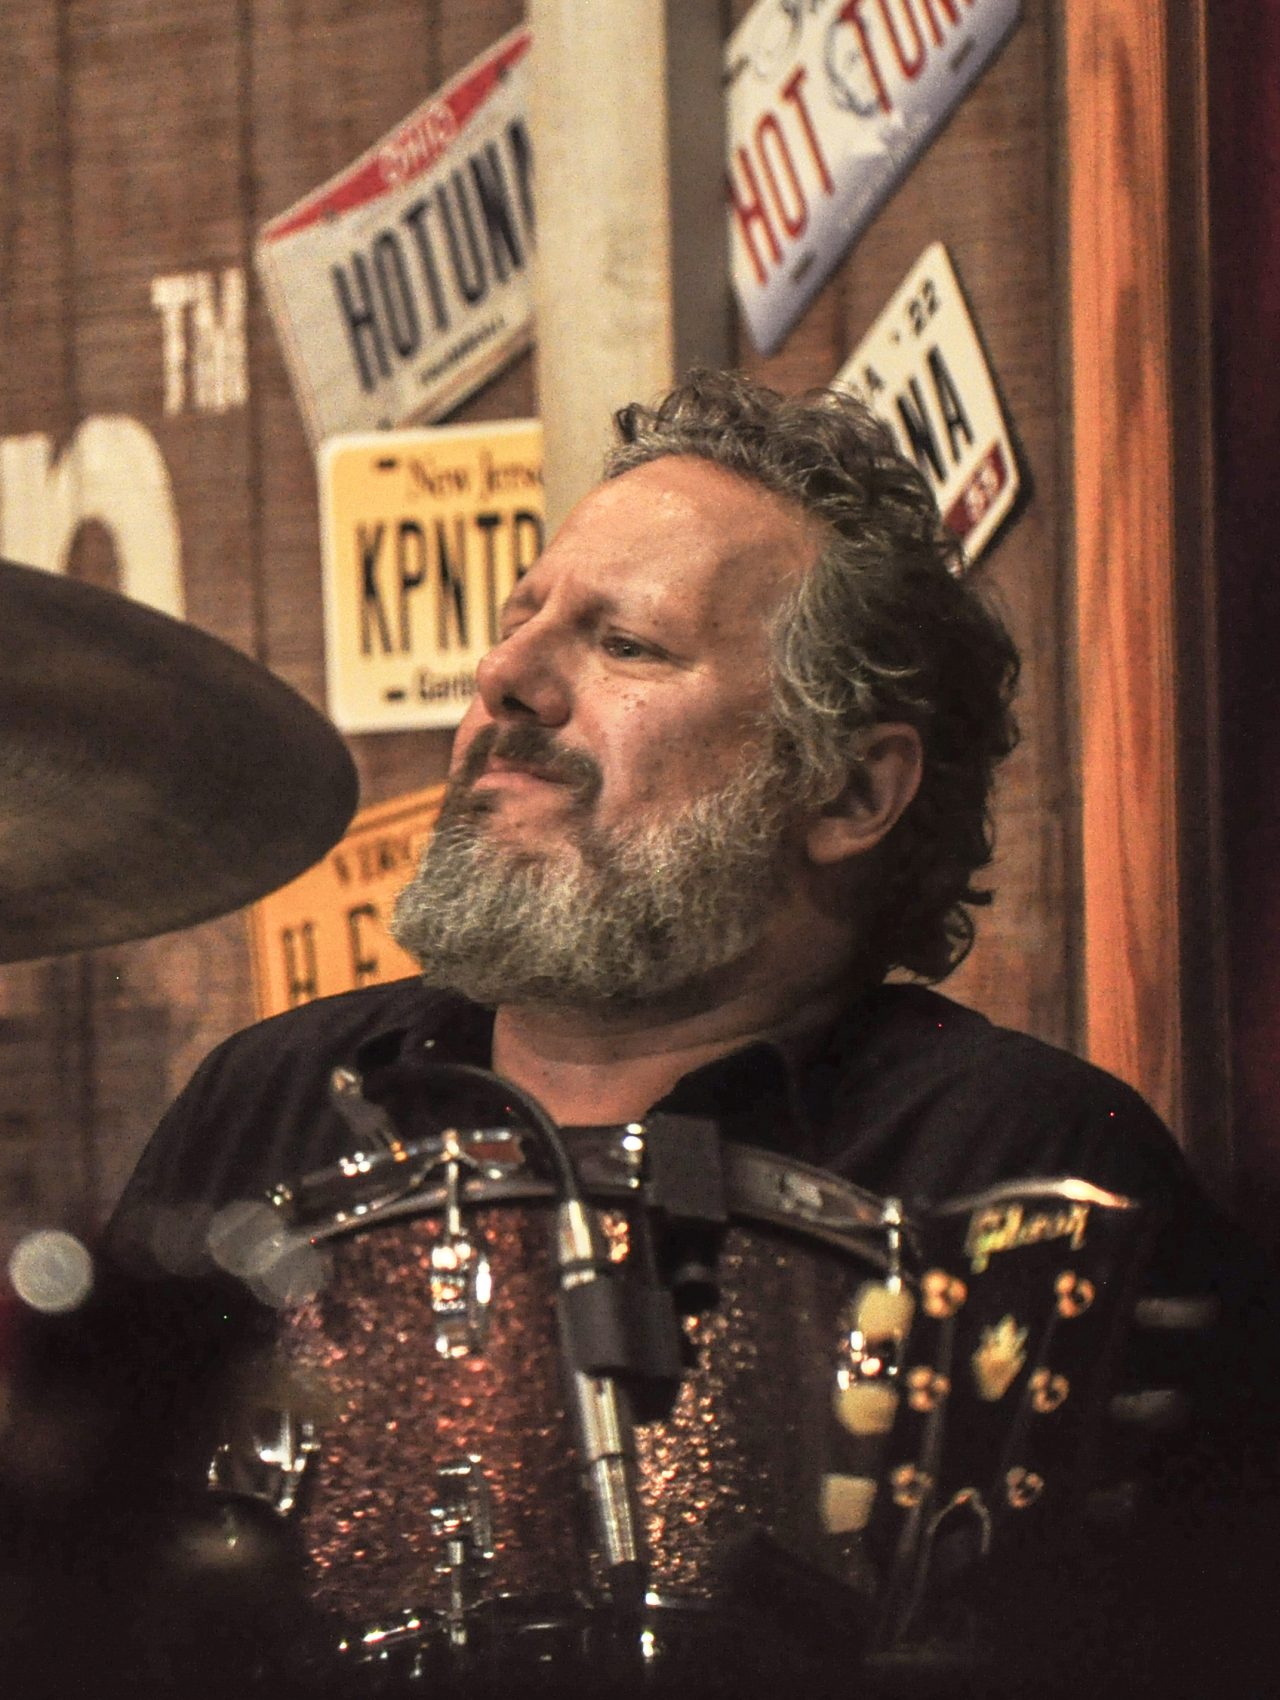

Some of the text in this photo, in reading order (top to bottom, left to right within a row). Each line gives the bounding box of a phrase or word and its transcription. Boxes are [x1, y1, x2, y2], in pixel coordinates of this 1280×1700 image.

[723, 65, 834, 285] HOT
[151, 268, 249, 414] TM
[408, 457, 468, 494] New
